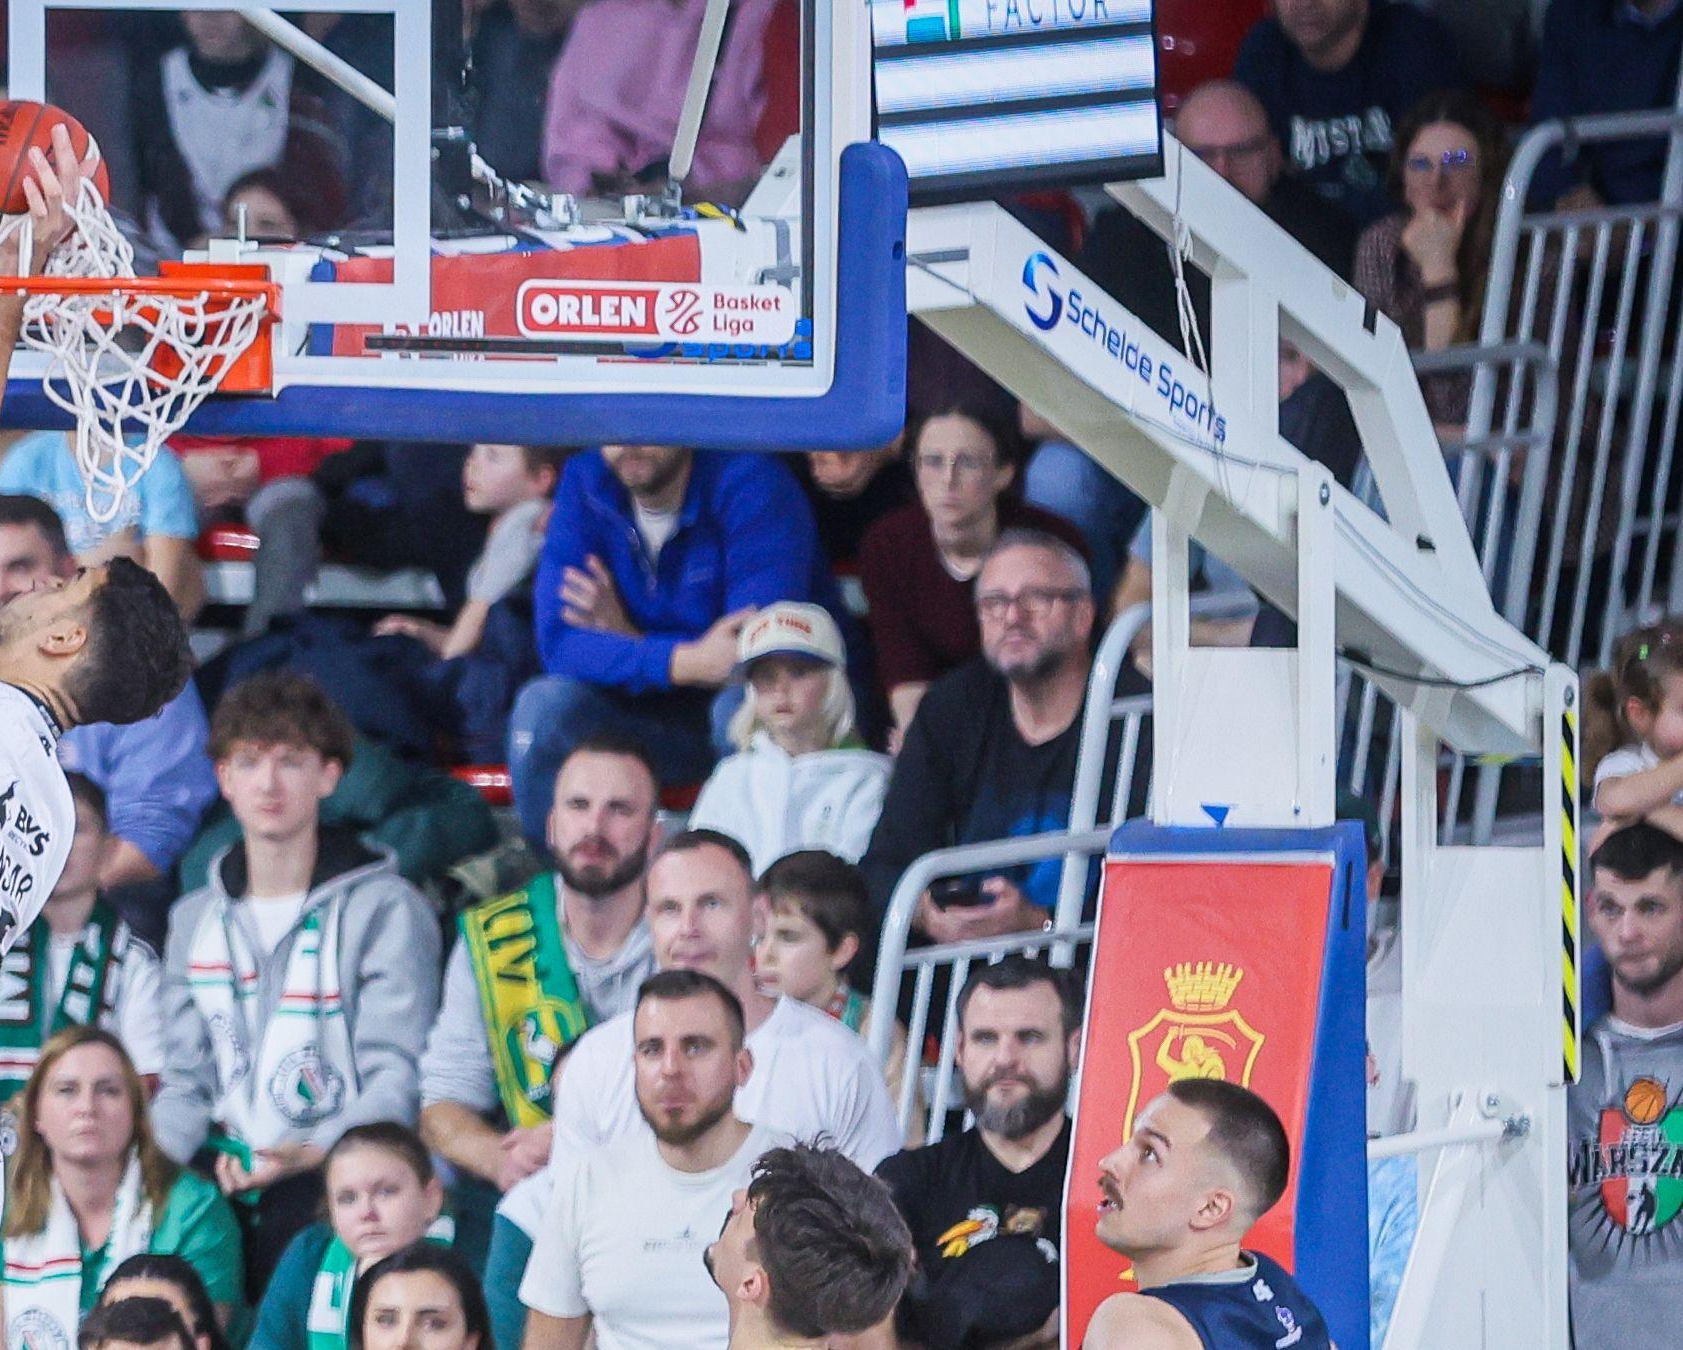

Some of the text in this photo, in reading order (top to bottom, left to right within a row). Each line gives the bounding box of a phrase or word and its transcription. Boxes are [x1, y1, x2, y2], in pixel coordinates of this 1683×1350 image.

[428, 309, 485, 338] ORLEN
[530, 292, 782, 328] ORLEN Basket
[712, 314, 755, 336] Liga
[1067, 288, 1227, 443] Schelde Sports
